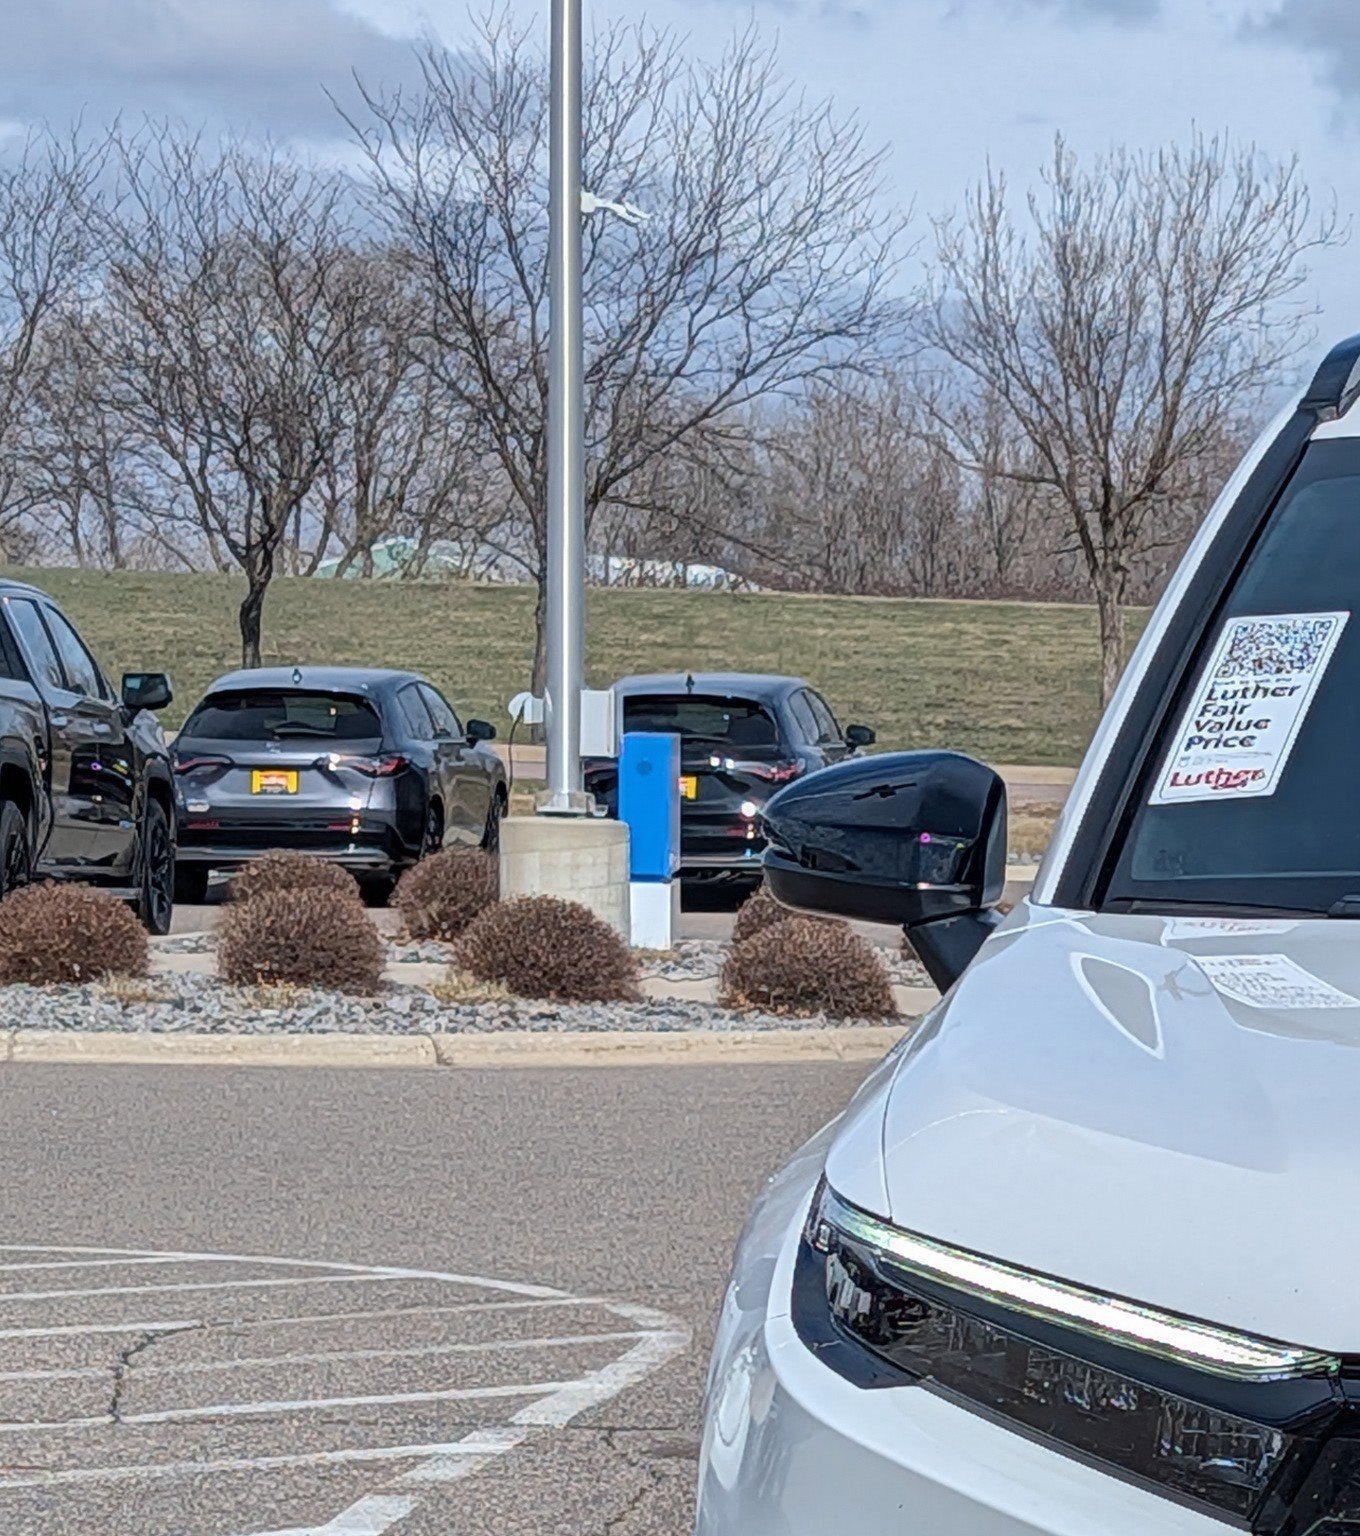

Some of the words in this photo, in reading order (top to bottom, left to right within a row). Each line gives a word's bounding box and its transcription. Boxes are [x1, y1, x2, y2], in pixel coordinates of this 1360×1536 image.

[1205, 684, 1301, 701] Luther
[1198, 700, 1250, 718] Fair
[1194, 717, 1271, 734] Value
[1184, 734, 1256, 751] Price
